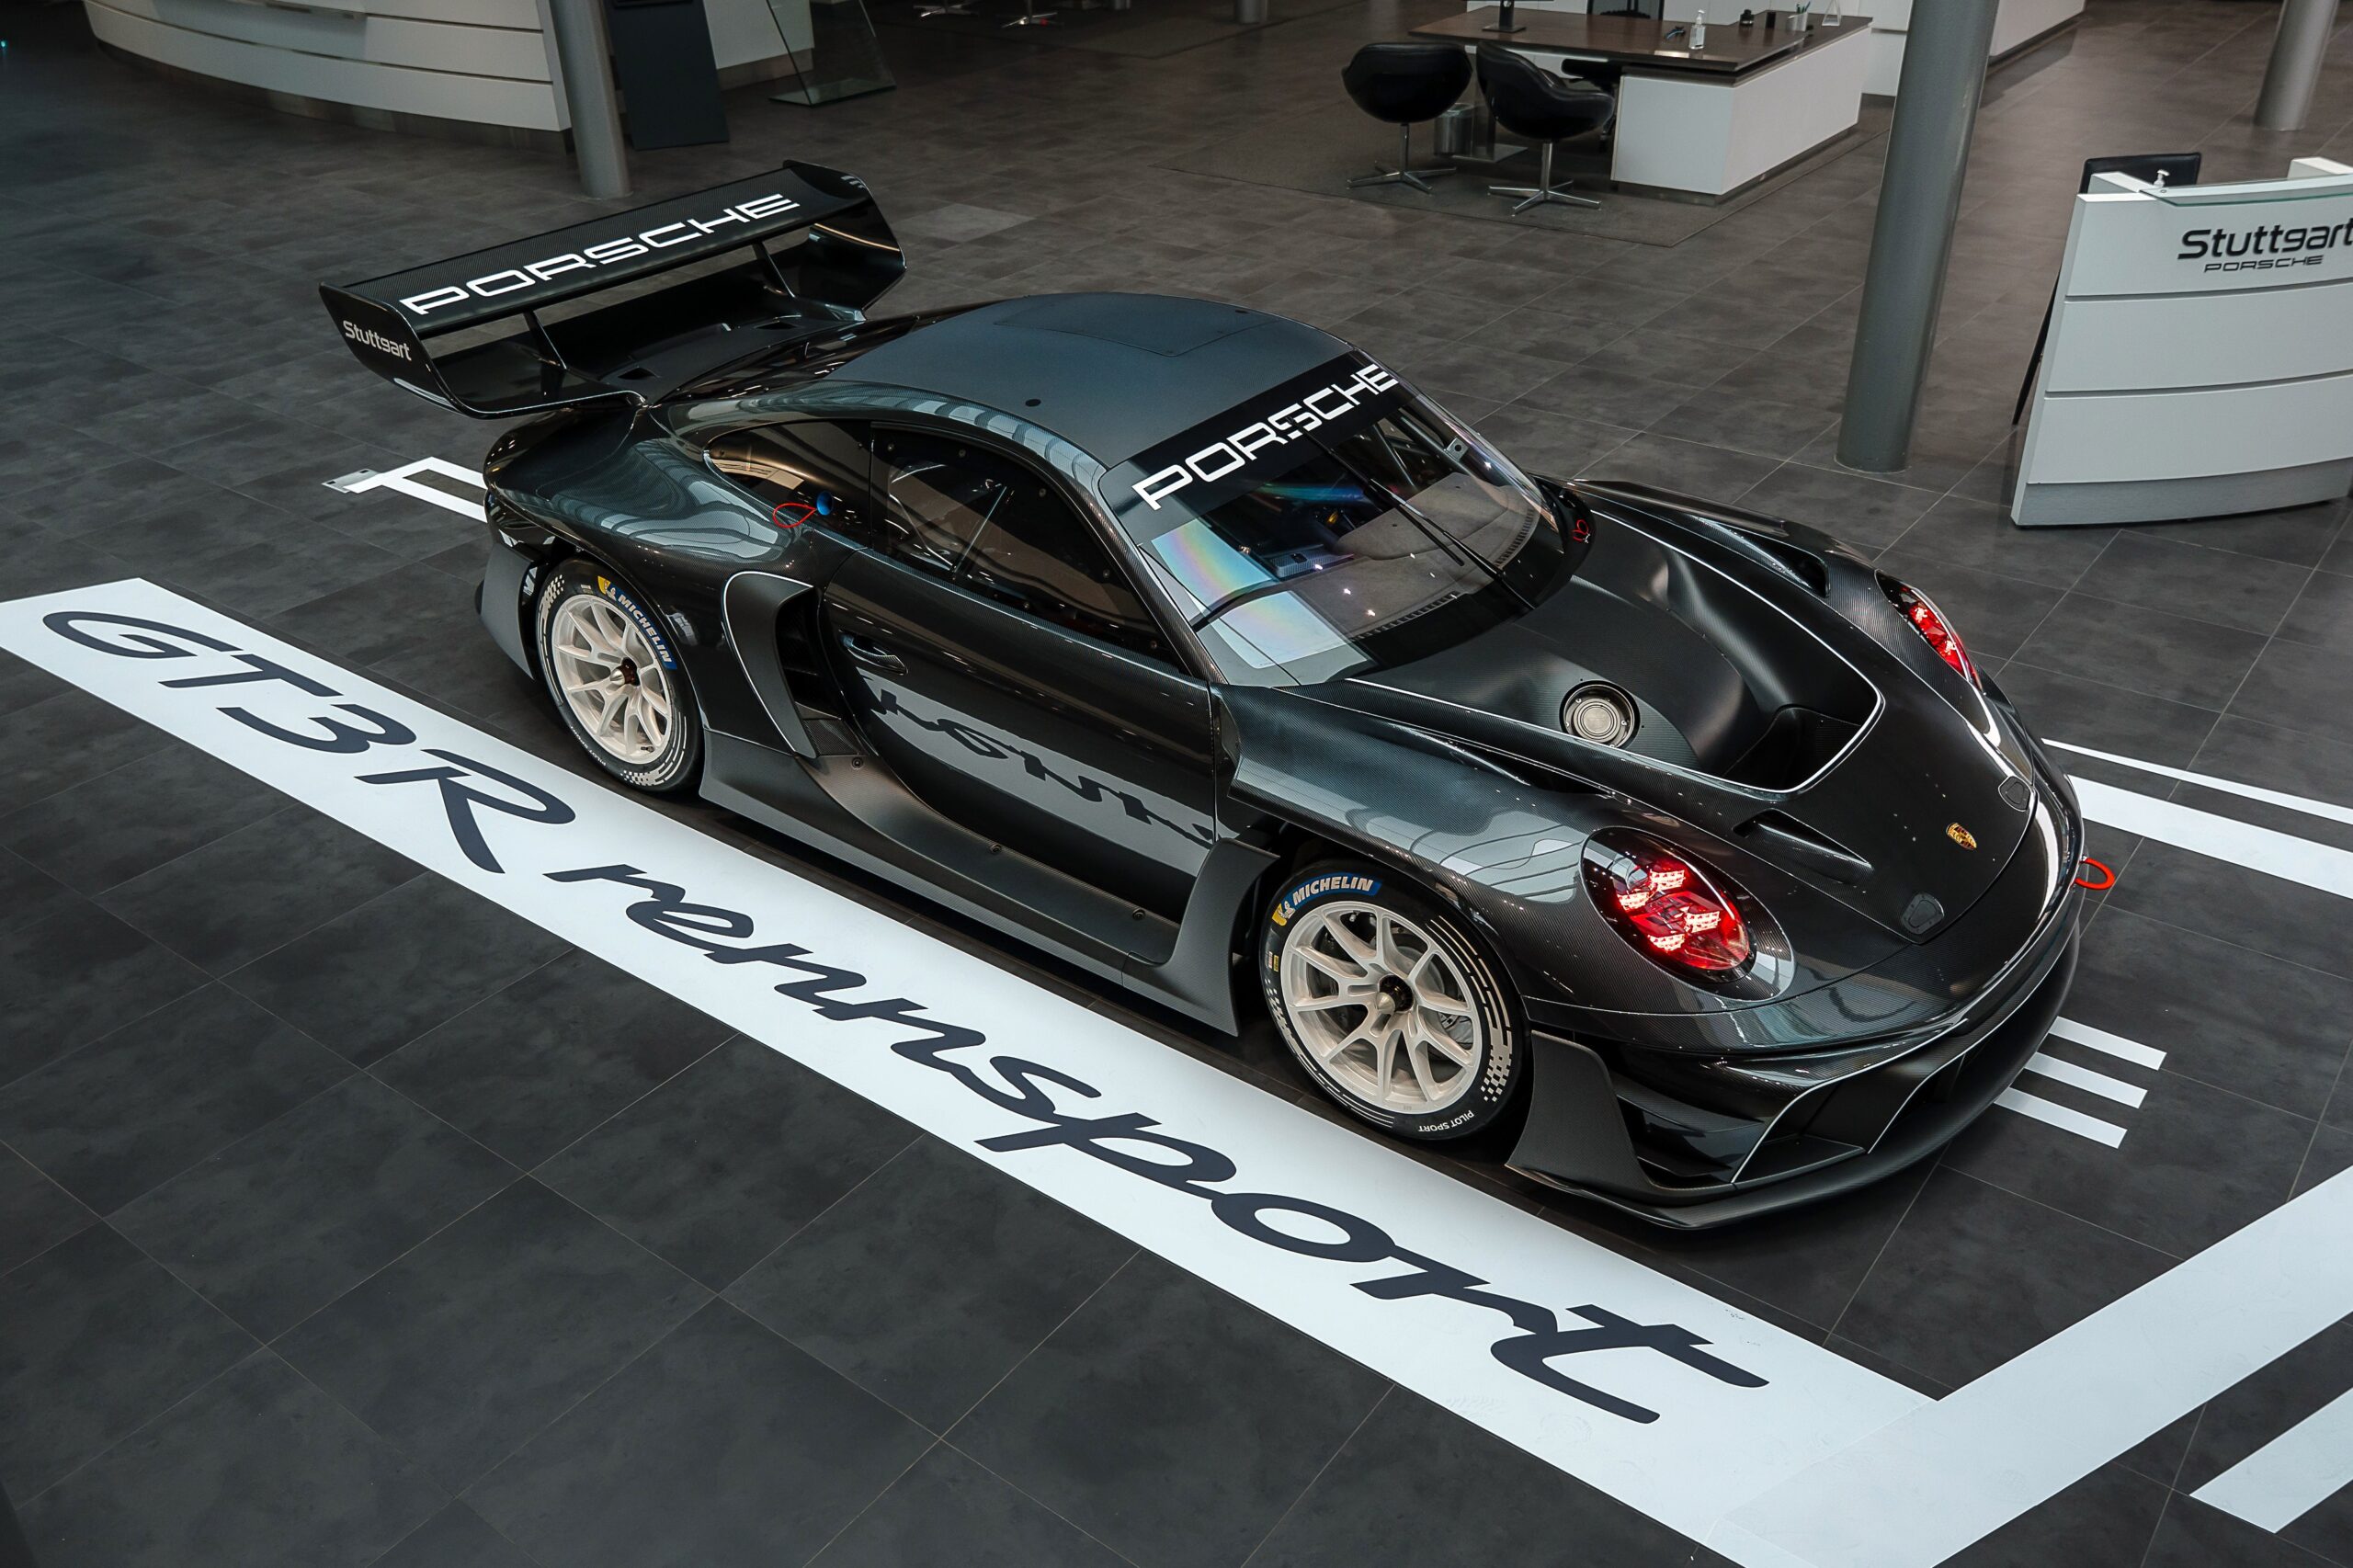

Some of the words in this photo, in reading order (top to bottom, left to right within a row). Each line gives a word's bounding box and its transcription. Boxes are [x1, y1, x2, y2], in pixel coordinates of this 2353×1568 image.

[399, 193, 801, 315] PORSCHE
[2177, 217, 2353, 260] Stuttgart
[2203, 255, 2324, 273] PORSCHE
[343, 320, 413, 361] Stuttgart
[1131, 363, 1399, 511] PORSCHE
[618, 594, 673, 663] MICHELIN
[1292, 876, 1374, 906] MICHELIN
[1417, 1121, 1450, 1132] SPORT
[1450, 1109, 1474, 1128] PILOT
[542, 863, 1770, 1425] rennsport
